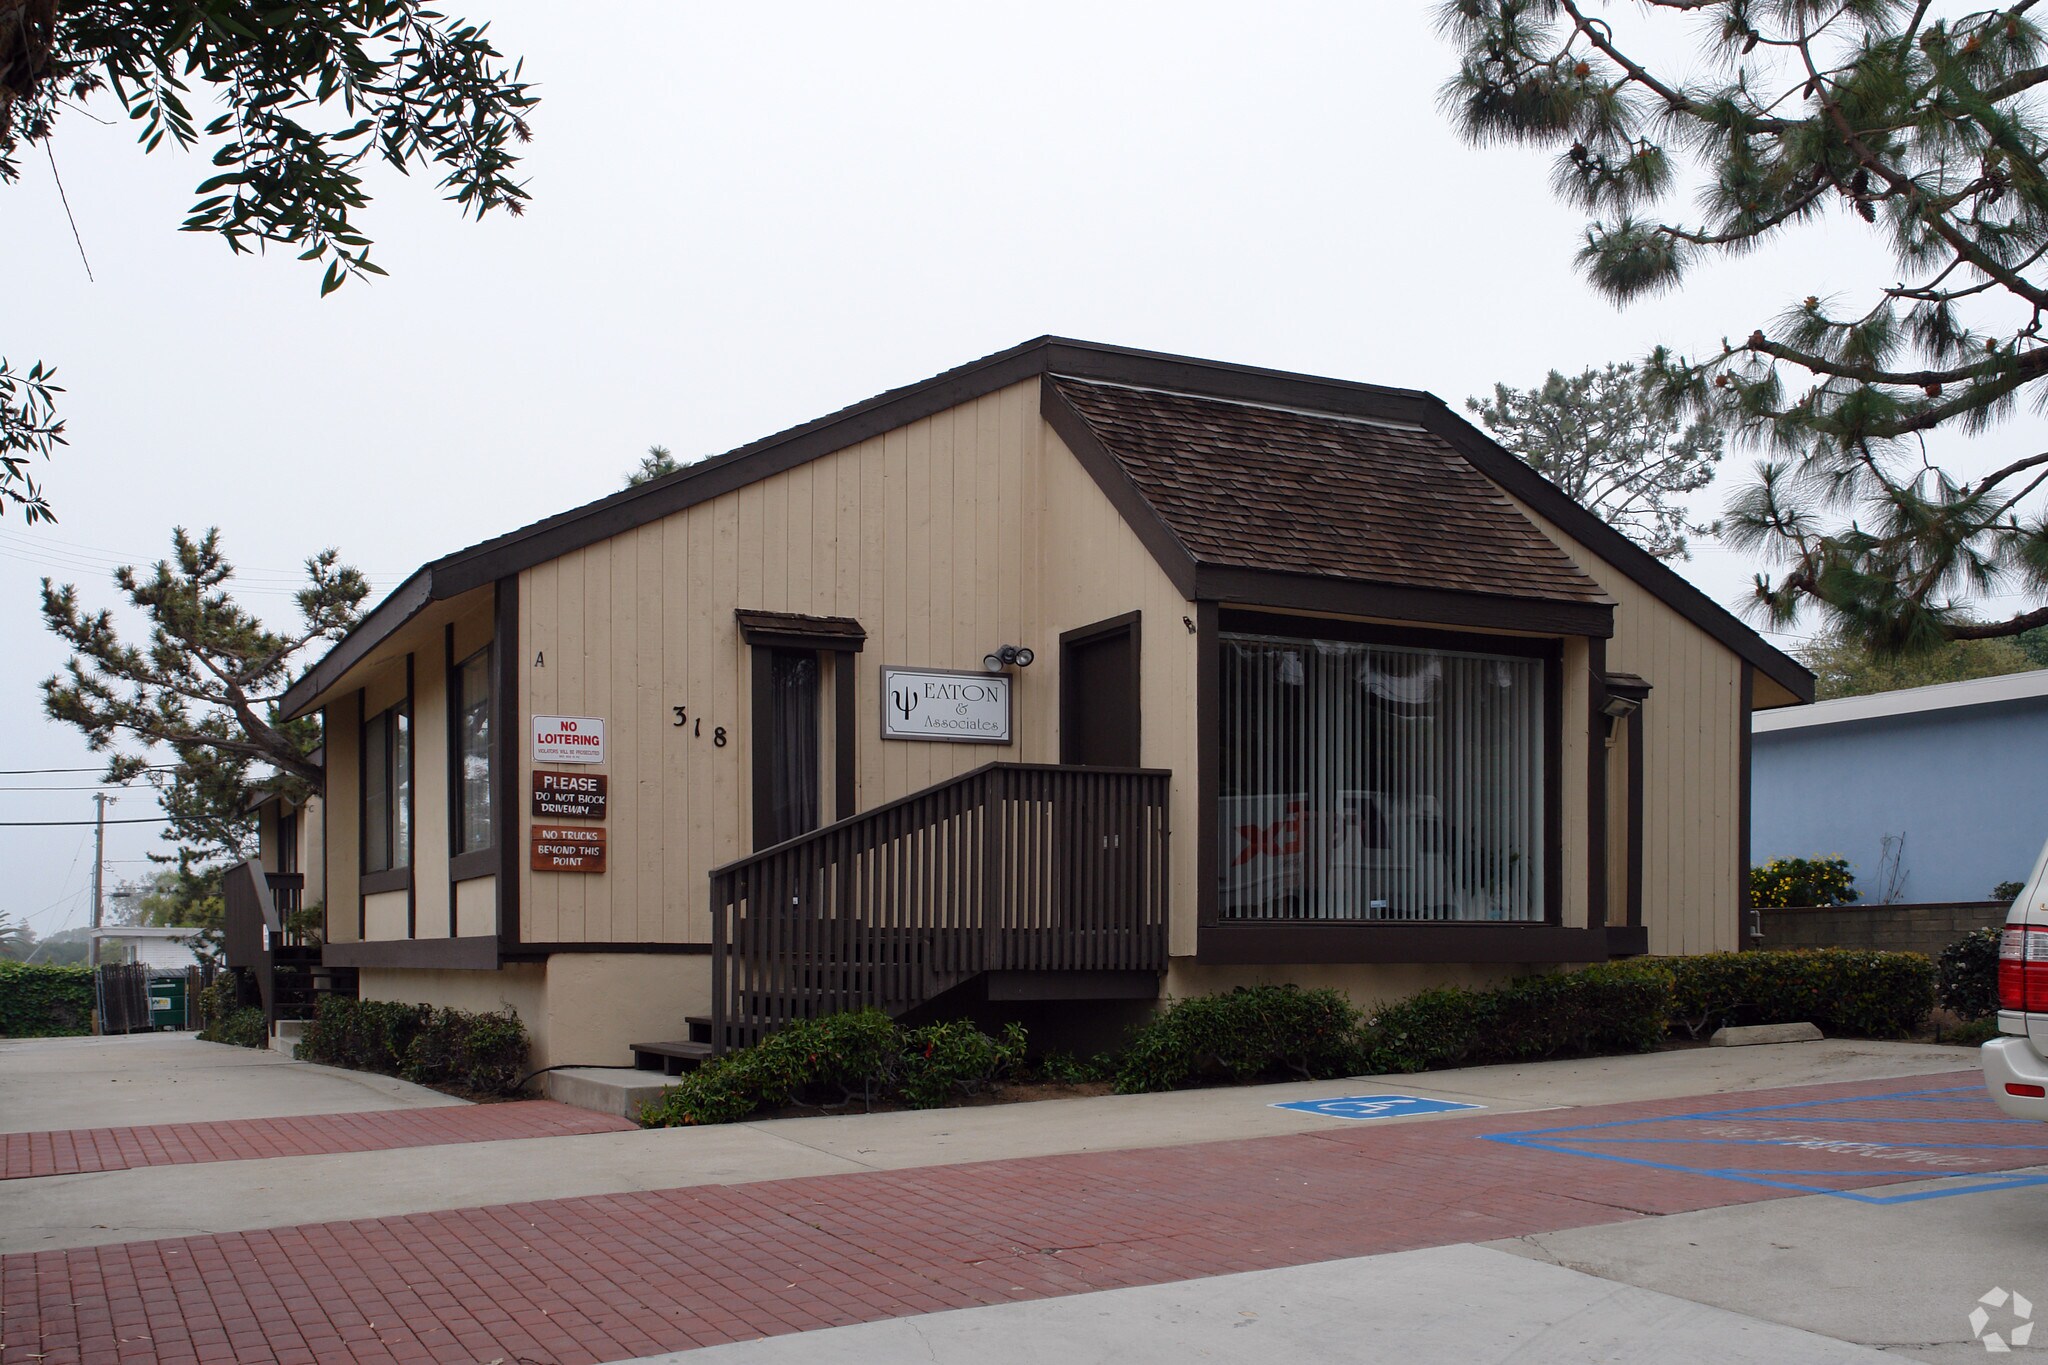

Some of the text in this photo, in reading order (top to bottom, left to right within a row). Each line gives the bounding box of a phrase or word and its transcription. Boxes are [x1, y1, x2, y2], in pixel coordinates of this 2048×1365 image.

[534, 651, 545, 667] A
[924, 682, 998, 703] EATON
[955, 702, 968, 715] &
[560, 721, 577, 732] NO
[924, 715, 999, 731] Associates
[537, 733, 600, 746] LOITERING
[544, 775, 597, 792] PLEASE
[535, 791, 550, 801] DO
[555, 793, 575, 802] NOT
[541, 803, 589, 815] DRIVEWAY
[542, 830, 598, 840] NO TRUCKS
[538, 845, 600, 856] BEYOND THIS
[553, 857, 583, 866] POINT
